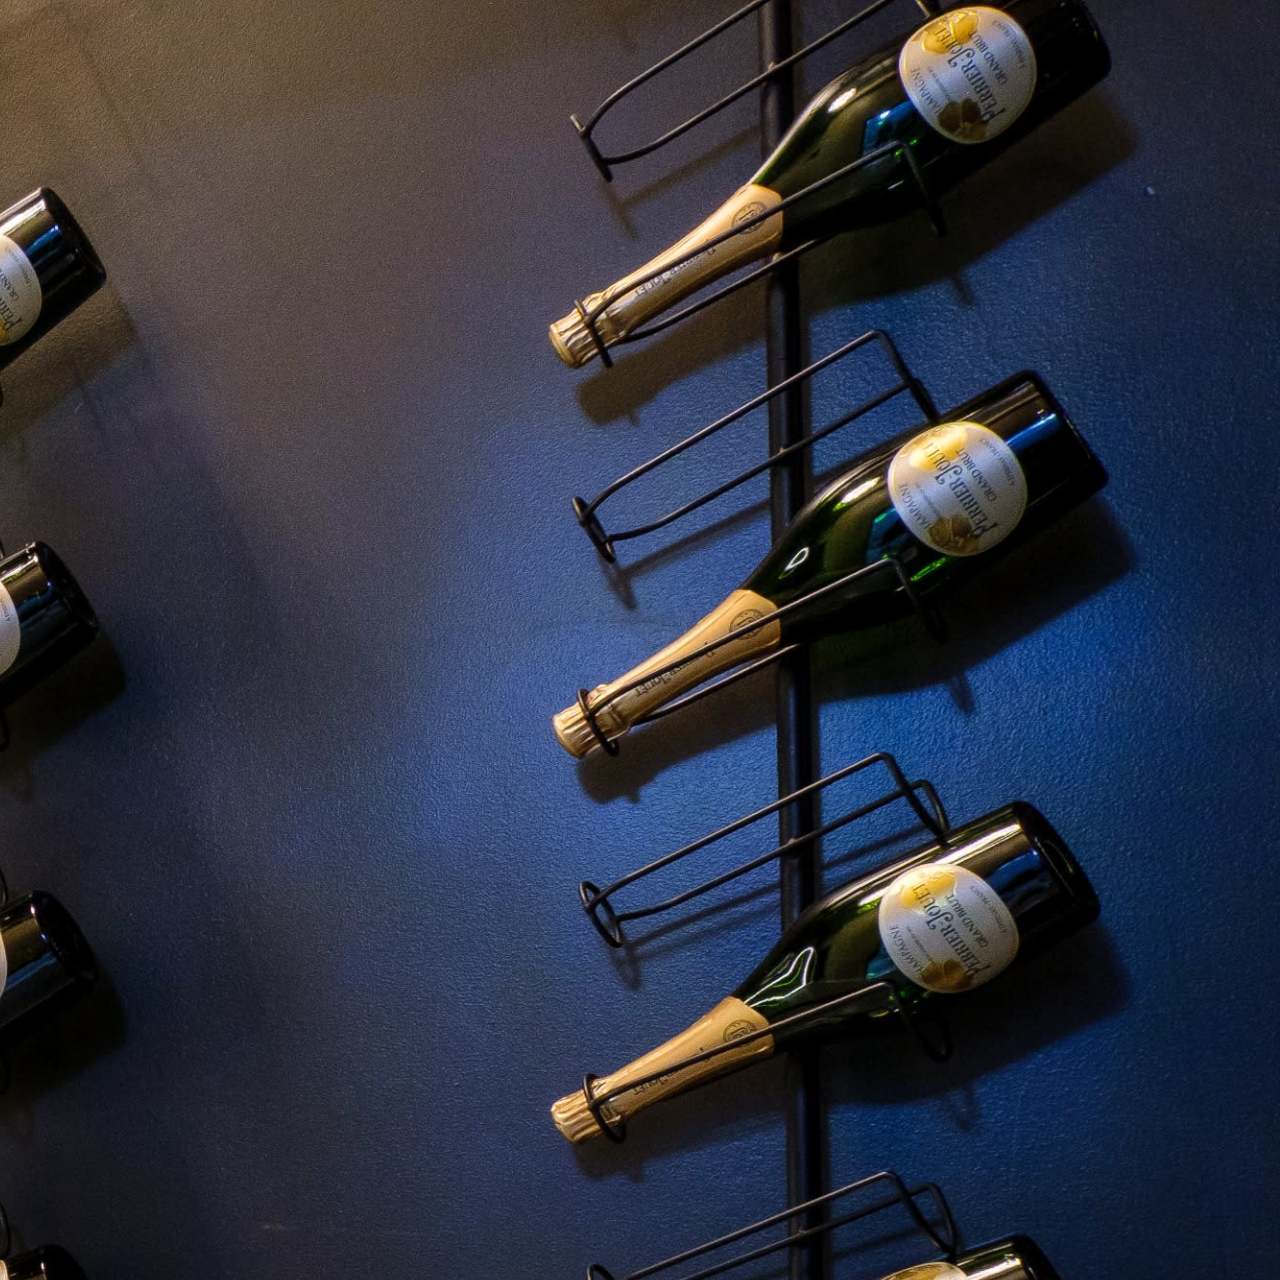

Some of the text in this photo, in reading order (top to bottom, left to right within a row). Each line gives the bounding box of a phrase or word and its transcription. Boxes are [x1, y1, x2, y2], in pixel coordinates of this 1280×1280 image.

[982, 50, 1007, 85] GRAND
[954, 446, 975, 469] BRUT
[970, 468, 997, 502] GRAND
[961, 915, 988, 948] GRAND
[888, 924, 923, 974] HAMPAGNE
